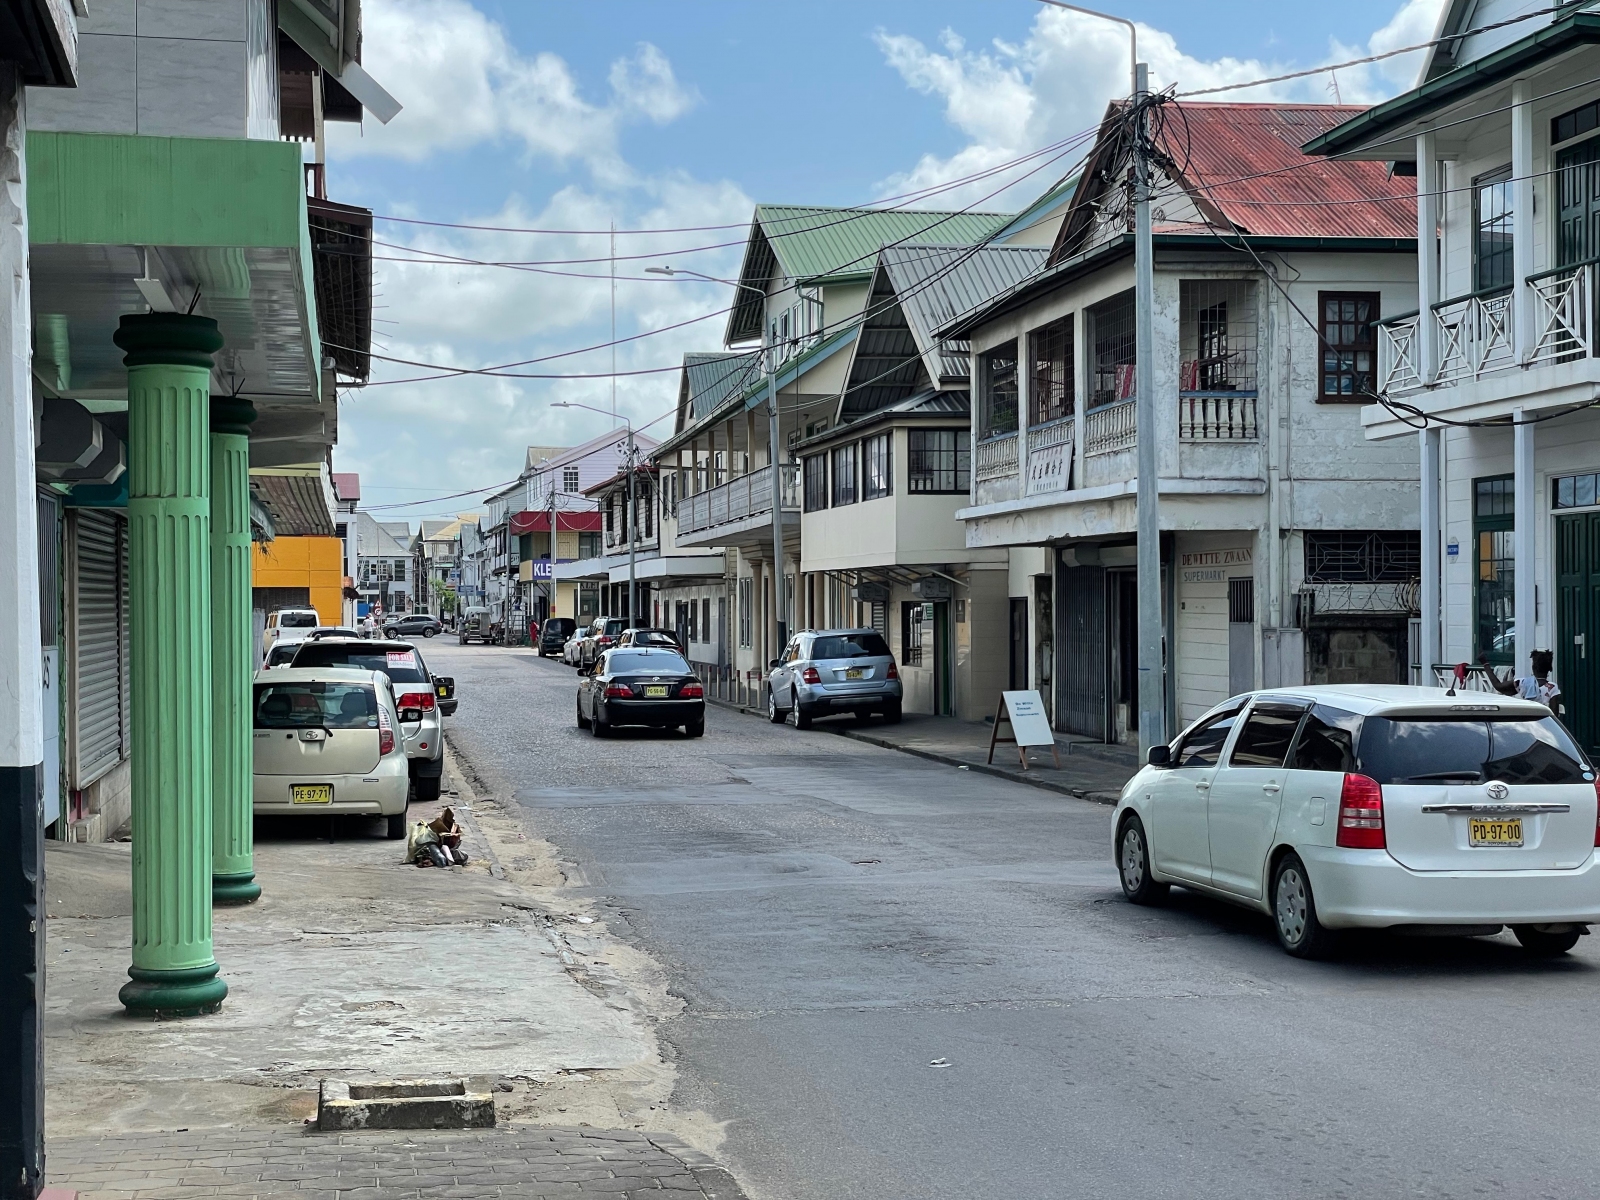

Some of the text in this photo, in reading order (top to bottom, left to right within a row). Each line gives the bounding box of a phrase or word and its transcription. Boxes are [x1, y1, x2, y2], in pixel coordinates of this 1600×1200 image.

[1224, 548, 1252, 563] ZWAAN
[1184, 570, 1226, 581] SUPERMARKT
[388, 653, 399, 661] FOR
[1473, 825, 1520, 839] PD-97-00
